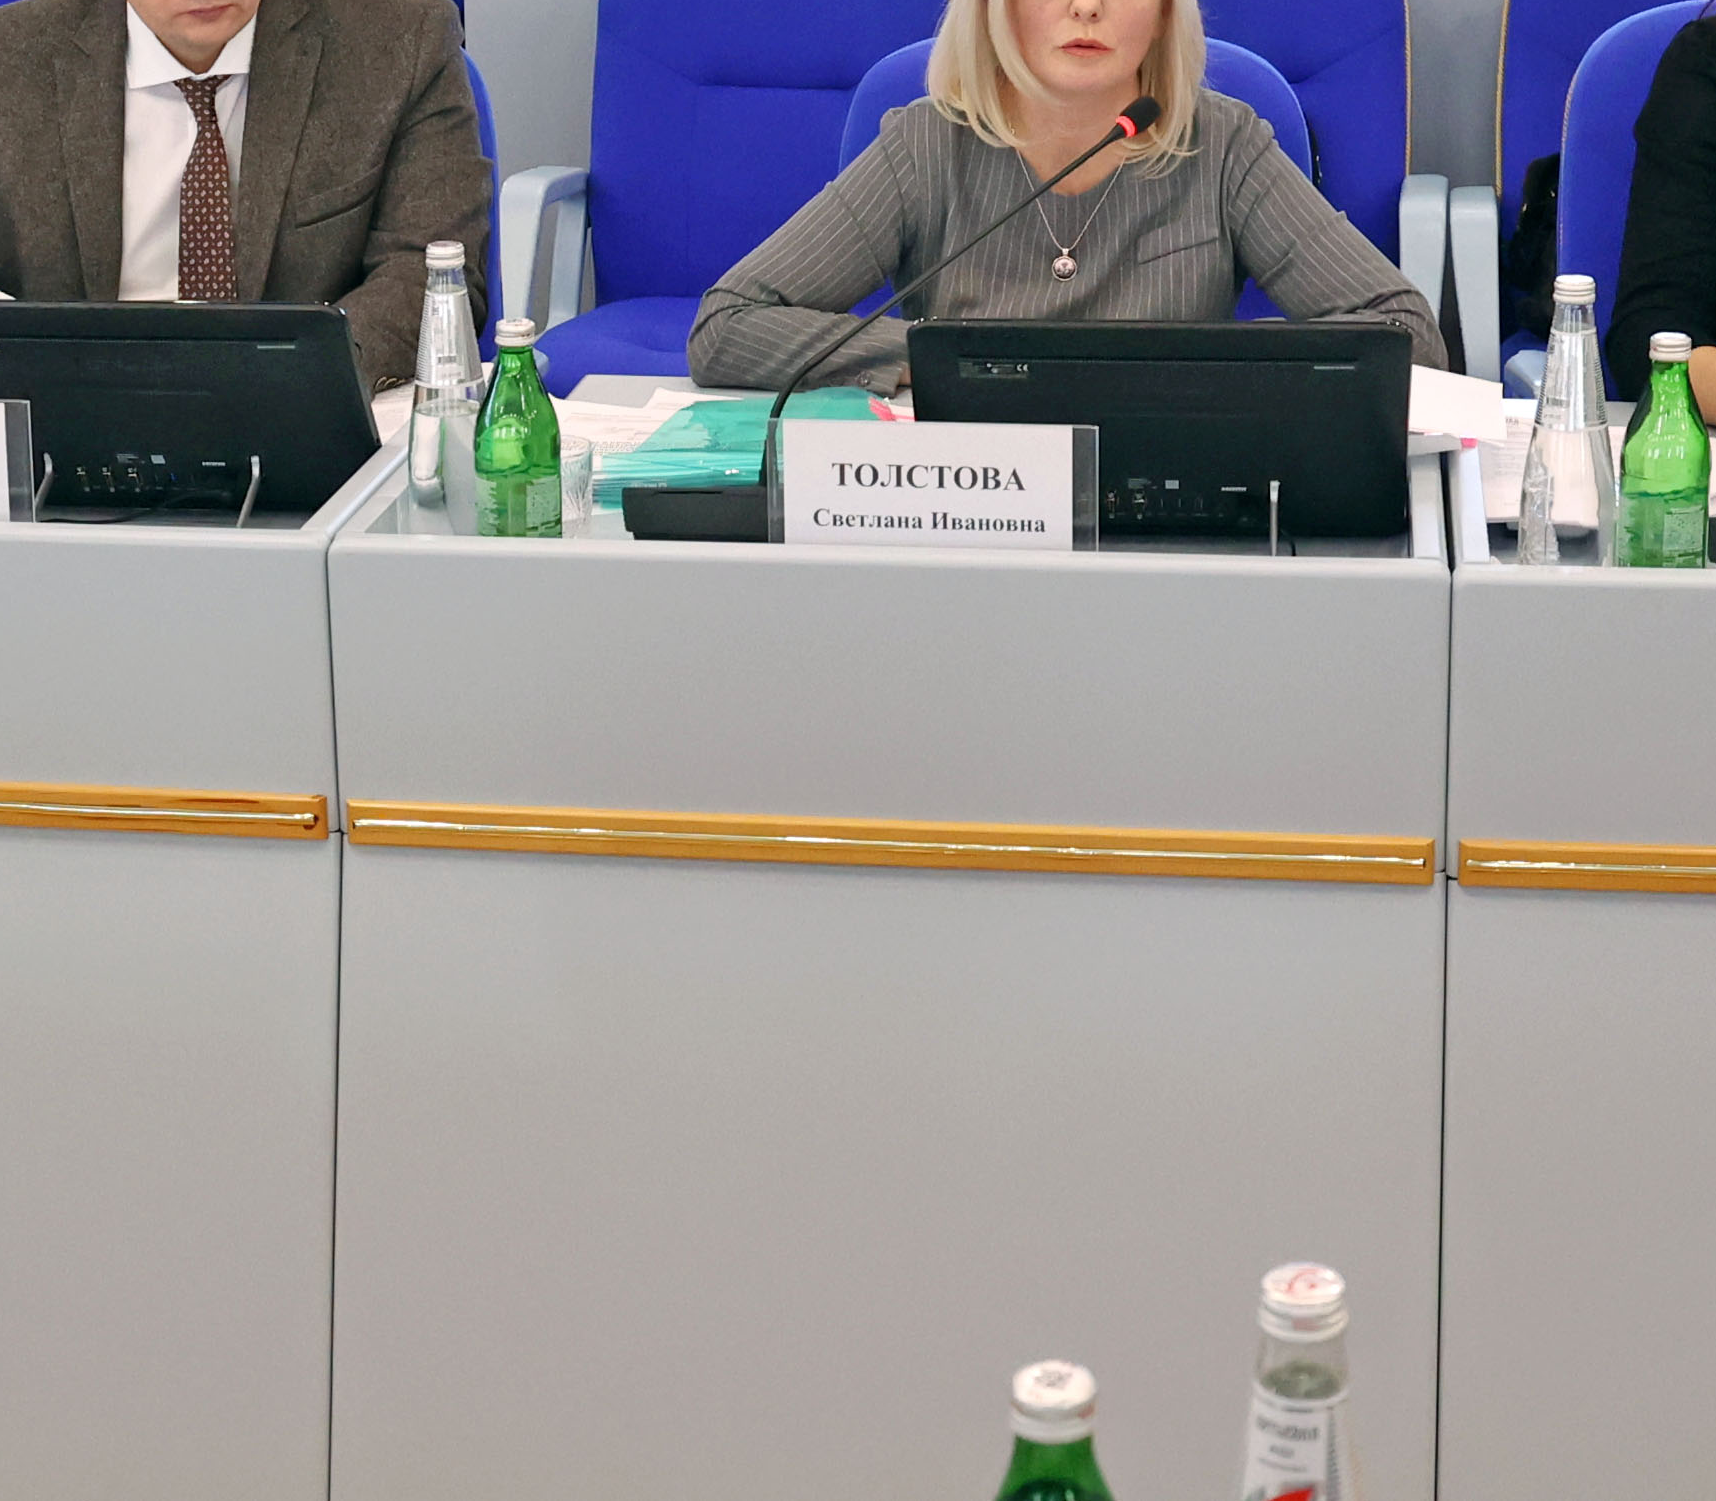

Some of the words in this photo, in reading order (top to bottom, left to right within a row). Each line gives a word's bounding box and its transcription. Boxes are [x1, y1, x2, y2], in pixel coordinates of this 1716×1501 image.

[831, 462, 1026, 492] ТОЛСТОВА
[813, 508, 924, 531] Светлана
[932, 511, 1046, 534] Ивановна
